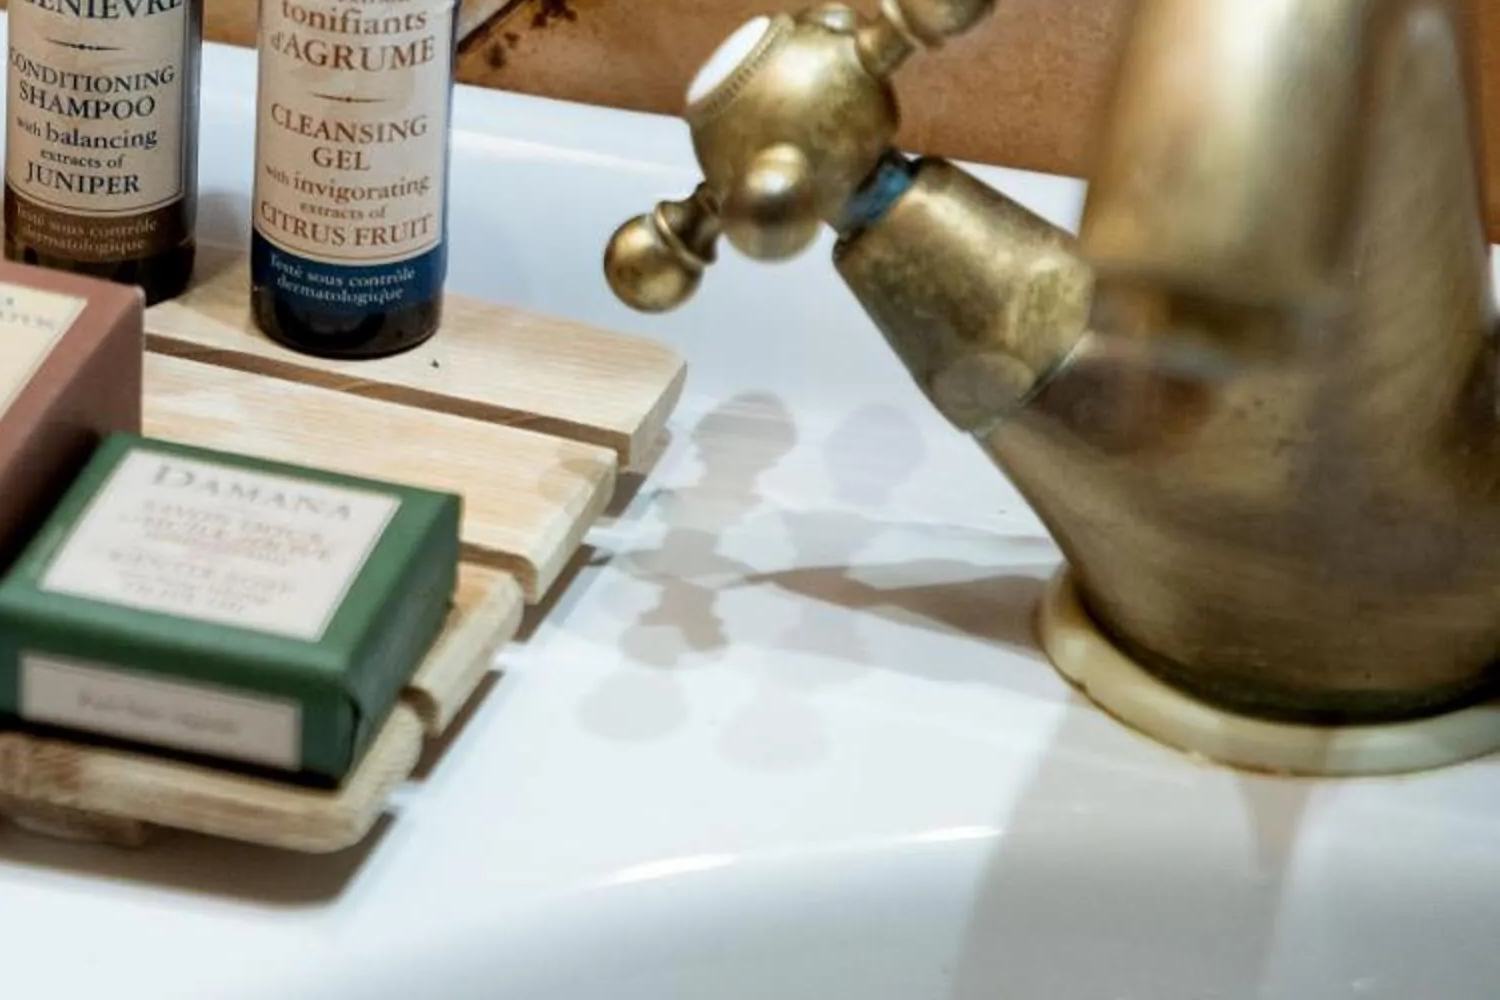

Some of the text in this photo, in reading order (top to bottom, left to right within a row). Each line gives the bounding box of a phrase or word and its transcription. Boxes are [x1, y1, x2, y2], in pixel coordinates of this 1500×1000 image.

[19, 80, 155, 120] SHAMPOO
[46, 119, 157, 150] balancing
[271, 103, 427, 145] CLEANSING
[41, 148, 124, 169] extracts of
[312, 146, 371, 172] GEL
[25, 161, 141, 195] JUNIPER
[293, 172, 431, 203] invigorating
[261, 201, 432, 247] CITRUS FRUIT
[300, 202, 387, 220] extracts of
